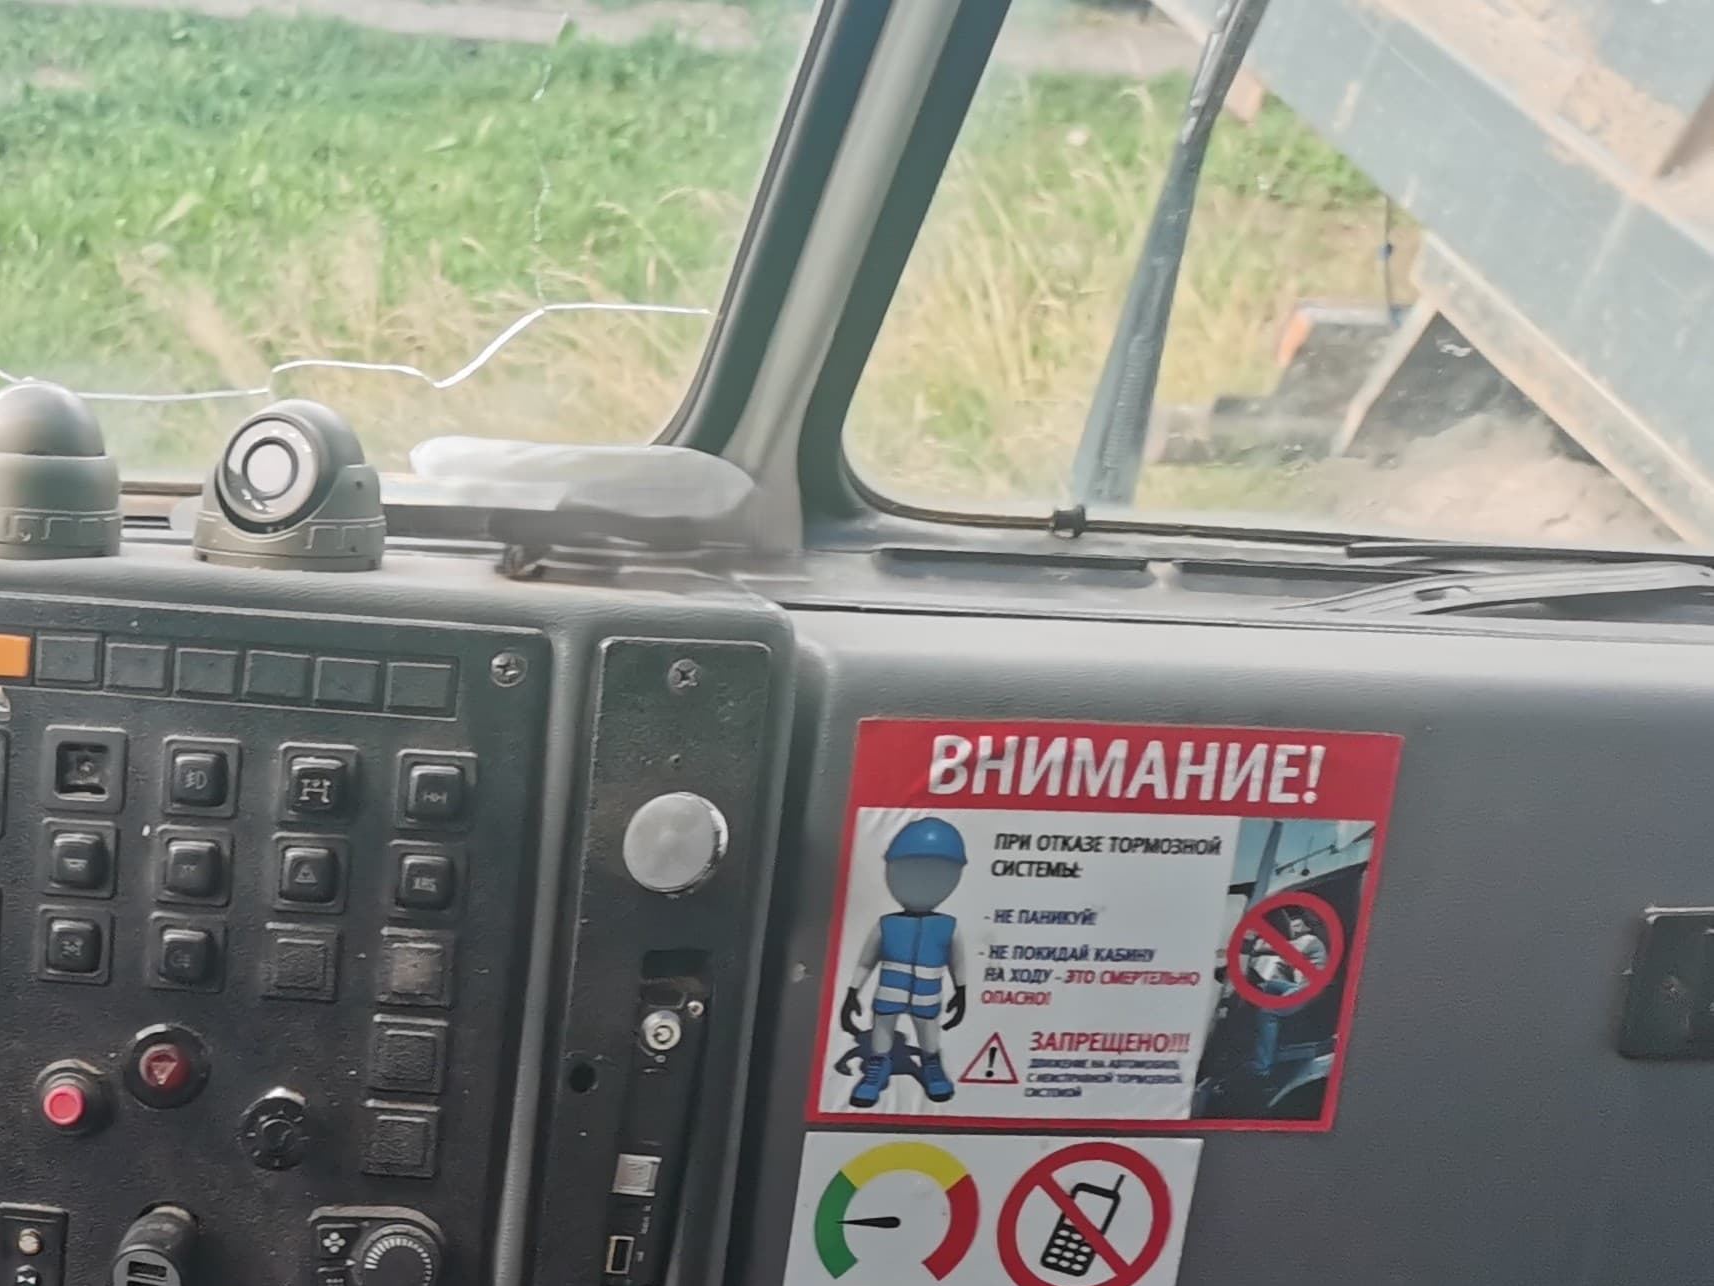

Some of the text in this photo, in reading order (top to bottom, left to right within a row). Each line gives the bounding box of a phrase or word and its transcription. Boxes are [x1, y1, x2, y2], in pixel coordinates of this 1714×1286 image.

[927, 734, 1326, 805] ВНИМАНИЕ!
[994, 833, 1222, 856] ПРИ ОТКАЗЕ ТОРМОЗНОЙ
[990, 859, 1083, 879] СИСТЕМЫ:
[994, 909, 1014, 924] НЕ
[989, 944, 1009, 959] НЕ
[1012, 944, 1089, 963] ПОКИДАЙ
[1094, 947, 1155, 963] КАБИНУ
[984, 968, 1006, 982] НА
[1009, 968, 1054, 983] ХОДУ
[1064, 970, 1095, 985] ЭТО
[1100, 970, 1201, 986] СМЕРТЕЛЬНО
[981, 990, 1051, 1005] ОПАСНО!
[1029, 1031, 1190, 1055] ЗАПРЕЩЕНО!!!
